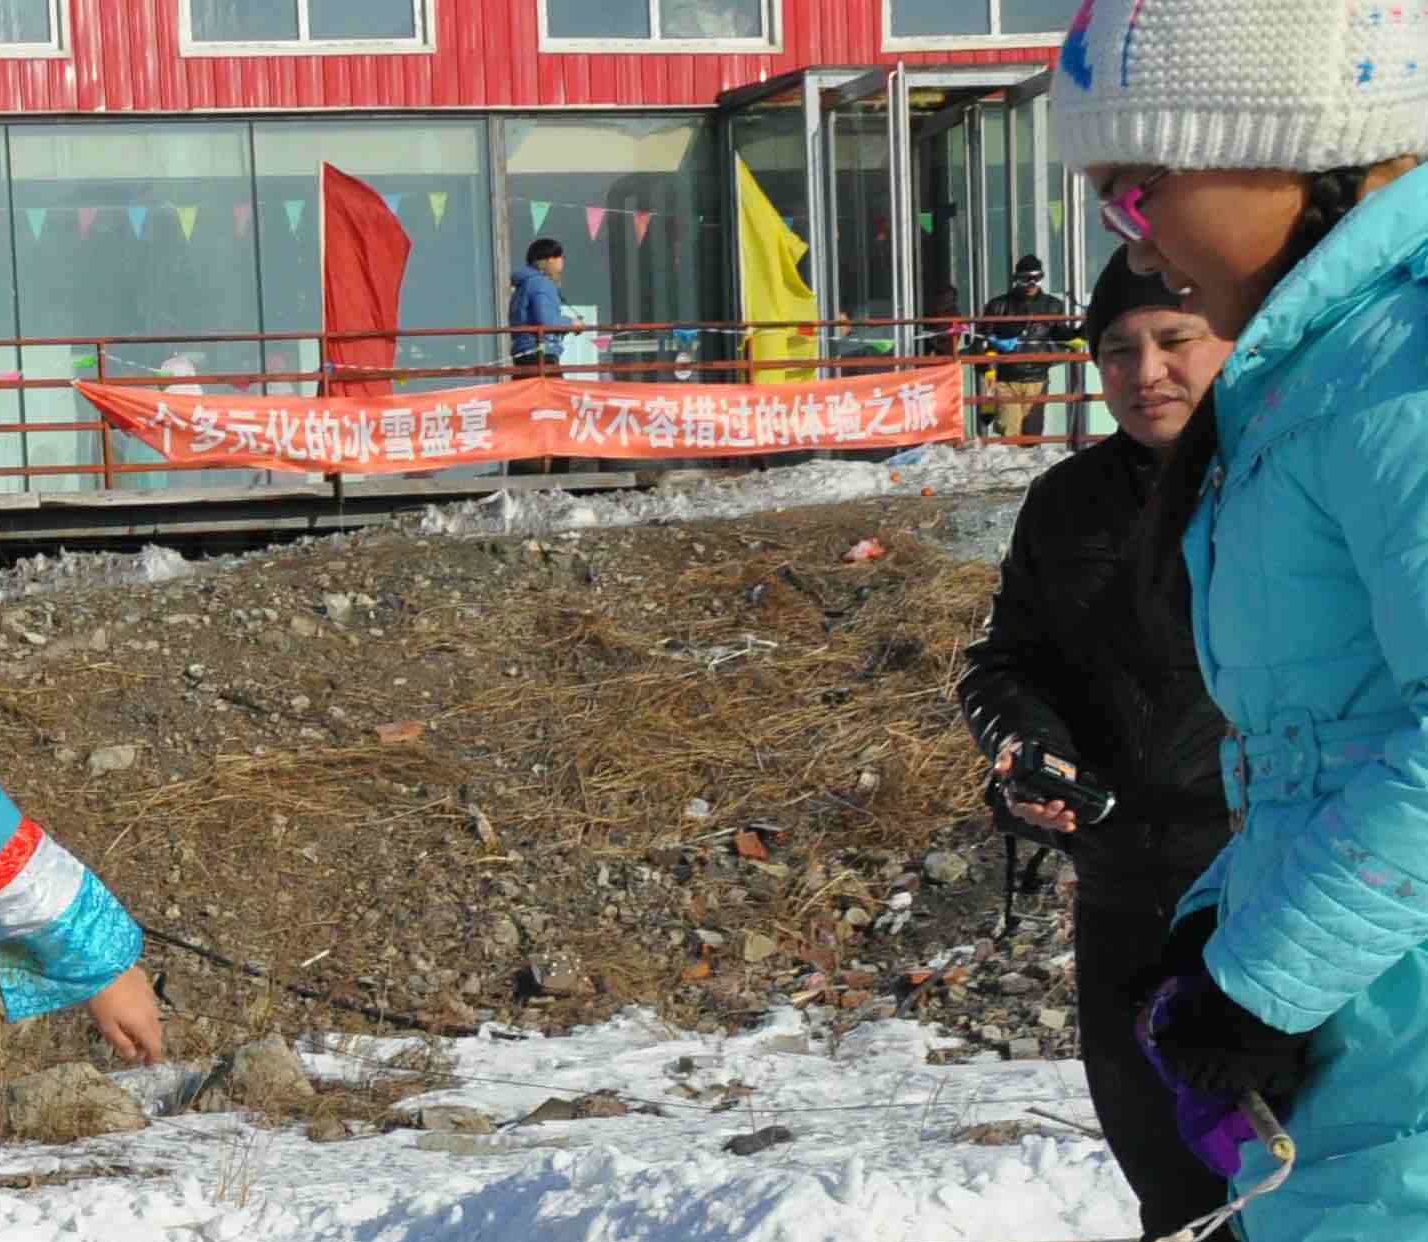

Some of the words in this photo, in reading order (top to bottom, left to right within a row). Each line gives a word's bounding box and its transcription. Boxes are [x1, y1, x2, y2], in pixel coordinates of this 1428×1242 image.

[530, 383, 939, 449] 一次不容错过的体验之旅
